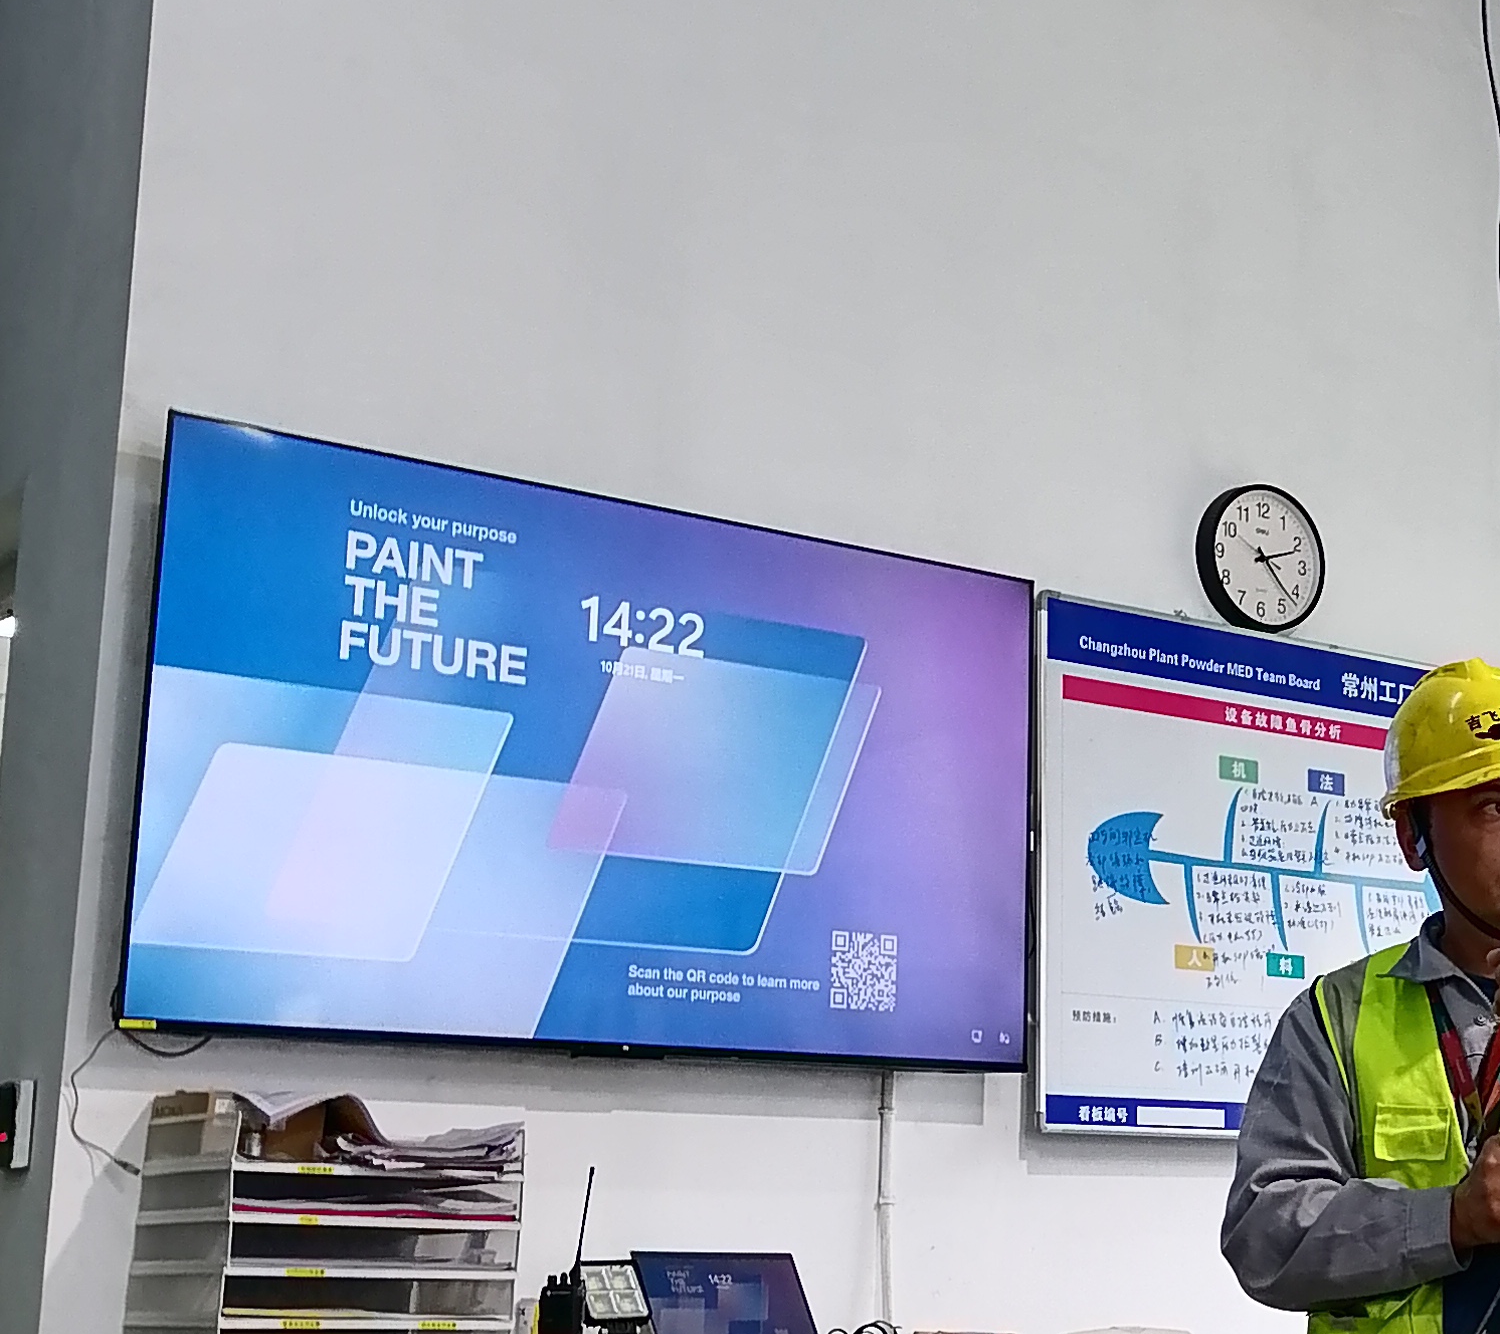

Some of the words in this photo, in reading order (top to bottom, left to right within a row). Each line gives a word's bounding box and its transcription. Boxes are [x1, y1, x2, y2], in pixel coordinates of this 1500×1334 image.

[1237, 506, 1249, 522] 11
[1256, 502, 1270, 519] 12
[350, 499, 407, 525] Unlock
[411, 511, 449, 533] your
[452, 521, 517, 544] purpose
[1222, 521, 1237, 538] 10
[1280, 516, 1286, 531] 1
[1215, 542, 1225, 558] 9
[1293, 537, 1302, 552] 2
[345, 529, 484, 589] PAINT
[1298, 560, 1307, 576] 3
[1222, 569, 1231, 585] 8
[1238, 590, 1246, 605] 7
[1291, 584, 1300, 599] 4
[344, 575, 440, 627] THE
[1256, 602, 1266, 618] 6
[1277, 598, 1287, 614] 5
[581, 595, 705, 659] 14:22
[339, 620, 528, 686] FUTURE
[1079, 635, 1147, 661] Changzhou
[1149, 648, 1179, 666] Plant
[1181, 654, 1225, 675] Powder
[1227, 661, 1253, 679] MED
[1256, 667, 1287, 685] Team
[1289, 672, 1321, 692] Board
[1224, 706, 1342, 740] 设备故障鱼骨分析
[1232, 761, 1247, 779] 机
[1320, 773, 1334, 792] 法
[1187, 948, 1202, 967] 人
[628, 965, 660, 982] Scan
[662, 967, 684, 982] the
[687, 970, 707, 985] QR
[709, 971, 739, 986] code
[742, 973, 755, 987] to
[757, 974, 788, 989] learn
[790, 979, 820, 992] more
[627, 983, 665, 999] about
[667, 989, 688, 1000] our
[690, 989, 741, 1004] purpose
[1078, 1105, 1129, 1123] 看板编号
